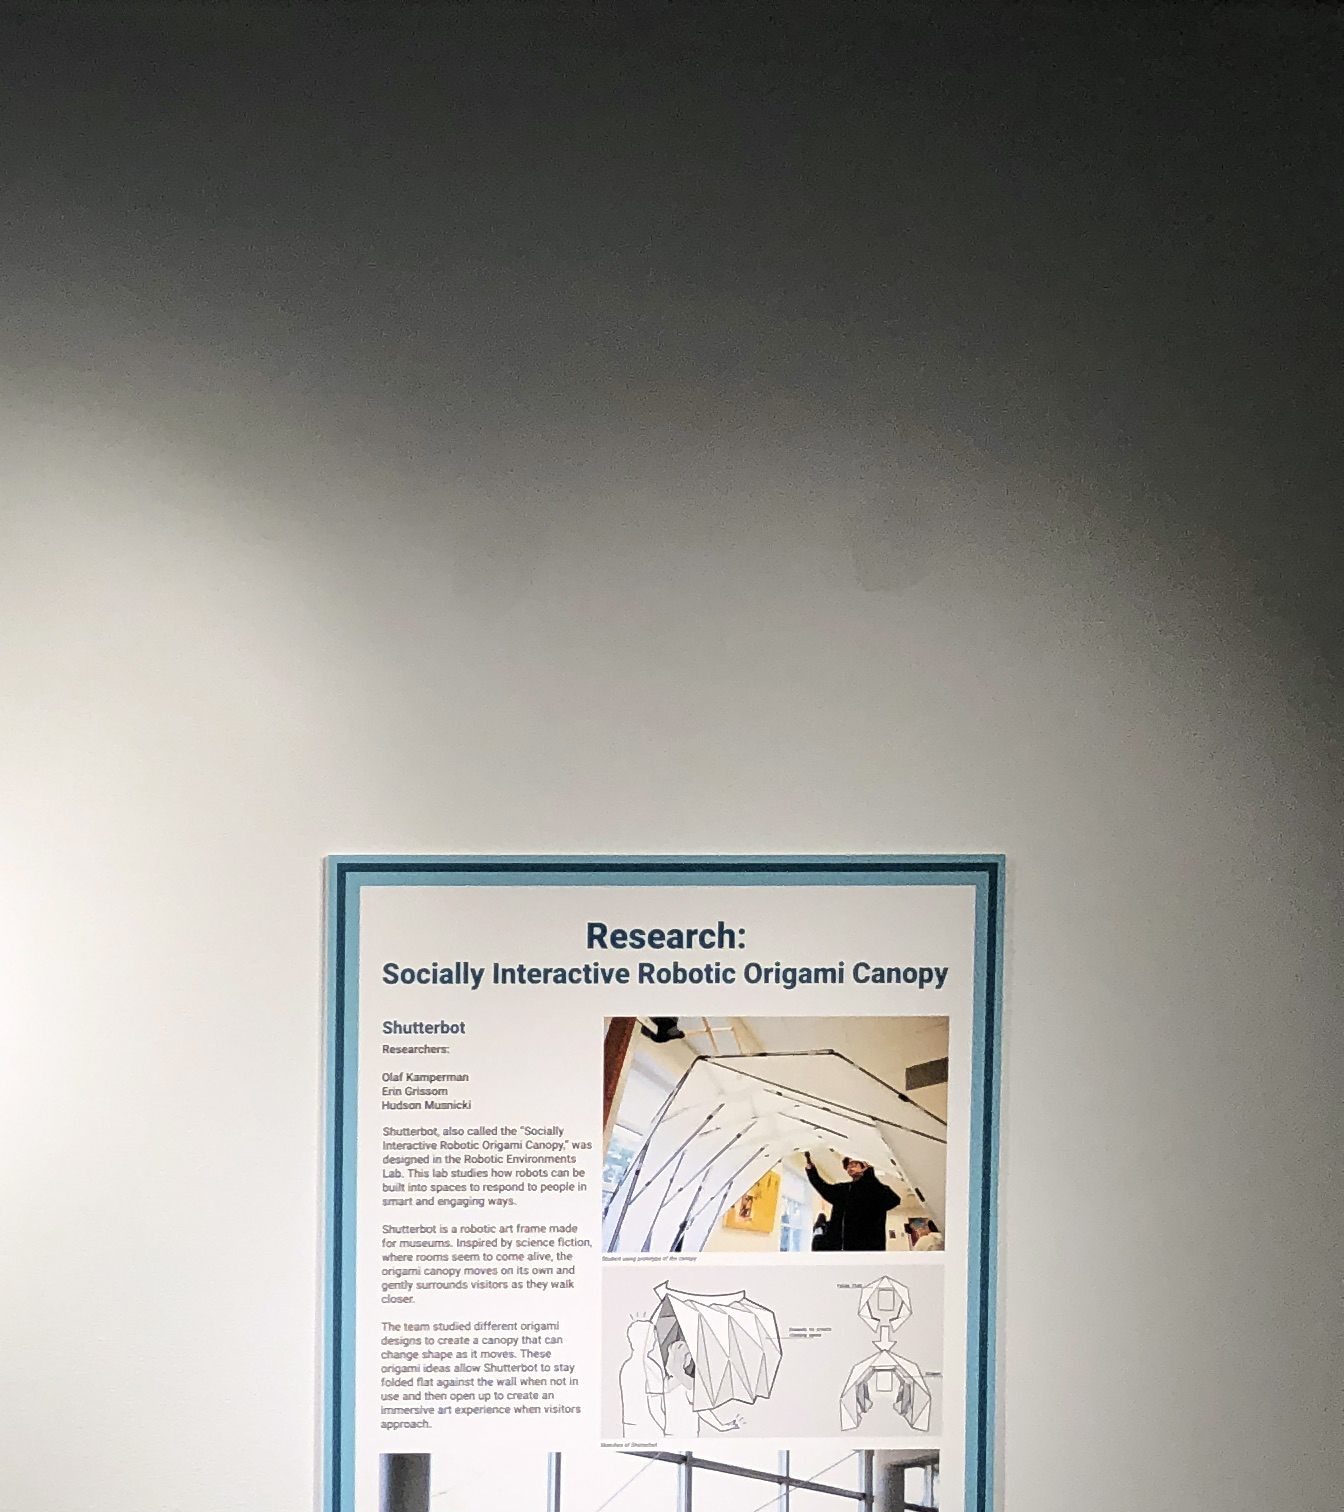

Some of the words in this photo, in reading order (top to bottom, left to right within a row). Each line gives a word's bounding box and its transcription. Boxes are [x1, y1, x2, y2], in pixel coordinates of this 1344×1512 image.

[587, 921, 745, 948] Research:
[382, 961, 485, 989] Socially
[492, 961, 630, 984] Interactive
[638, 961, 736, 984] Robotic
[743, 961, 844, 989] Origami
[852, 962, 948, 989] Canopy
[382, 1020, 465, 1034] Shutterbot
[382, 1044, 450, 1053] Researchers:
[381, 1071, 404, 1081] Olaf
[405, 1072, 469, 1084] Kamperman
[381, 1086, 402, 1095] Erin
[404, 1086, 448, 1096] Grissom
[381, 1100, 422, 1110] Hudson
[424, 1100, 471, 1110] Musnicki
[442, 1126, 464, 1135] also
[466, 1126, 498, 1135] called
[500, 1126, 517, 1135] the
